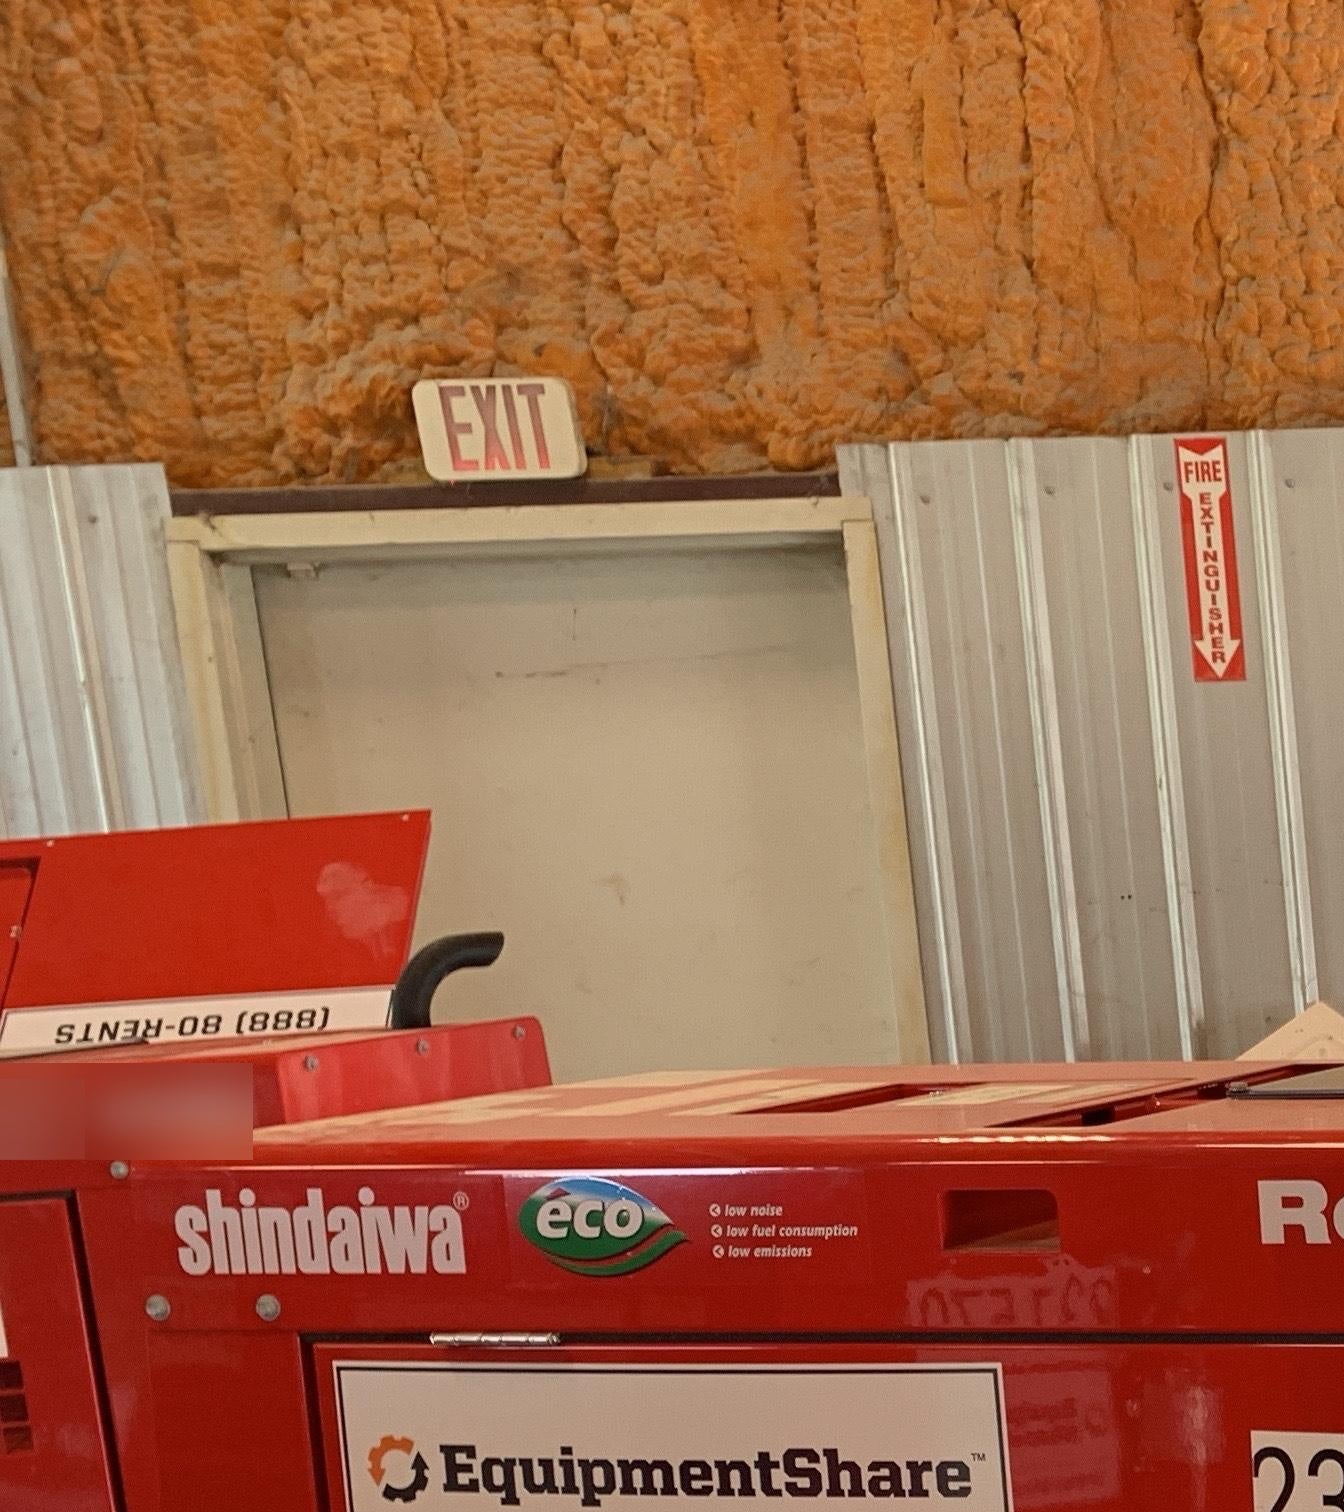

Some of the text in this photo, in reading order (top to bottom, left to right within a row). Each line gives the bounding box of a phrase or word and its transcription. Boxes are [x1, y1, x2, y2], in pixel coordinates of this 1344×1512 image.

[438, 382, 552, 472] EXIT
[1183, 460, 1223, 484] FIRE
[1198, 493, 1227, 664] EXTINGUISHER
[236, 1006, 331, 1035] (888)
[535, 1197, 646, 1239] eco
[724, 1203, 783, 1217] low noise
[726, 1223, 859, 1240] low fuel consumption
[728, 1244, 813, 1258] low emissions
